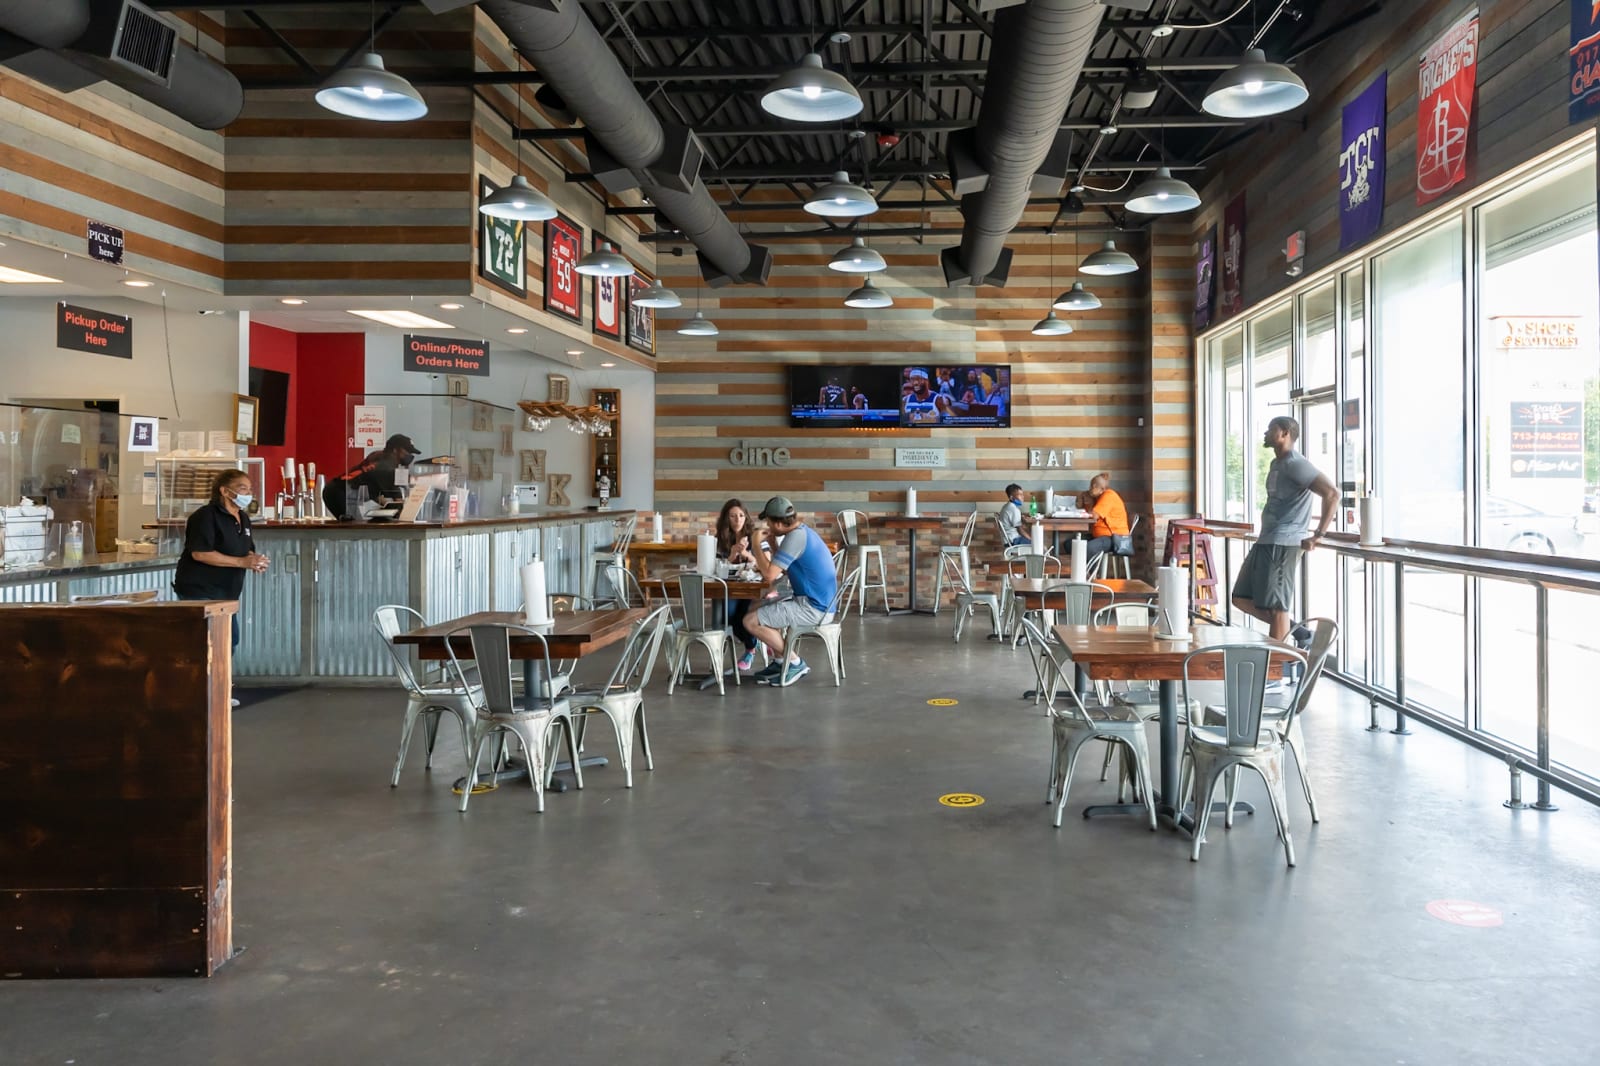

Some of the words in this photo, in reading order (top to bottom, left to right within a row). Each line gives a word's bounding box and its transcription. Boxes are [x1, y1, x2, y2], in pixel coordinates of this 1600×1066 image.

[88, 229, 110, 244] PICK
[111, 236, 123, 248] UP
[98, 245, 114, 258] here
[494, 226, 514, 276] 72
[556, 256, 571, 294] 59
[65, 311, 97, 331] Pickup
[99, 318, 125, 334] Order
[85, 332, 107, 347] Here
[410, 341, 484, 357] Online/Phone
[416, 355, 453, 369] Orders
[455, 358, 480, 370] Here
[729, 439, 791, 467] dine
[1029, 448, 1074, 468] EAT
